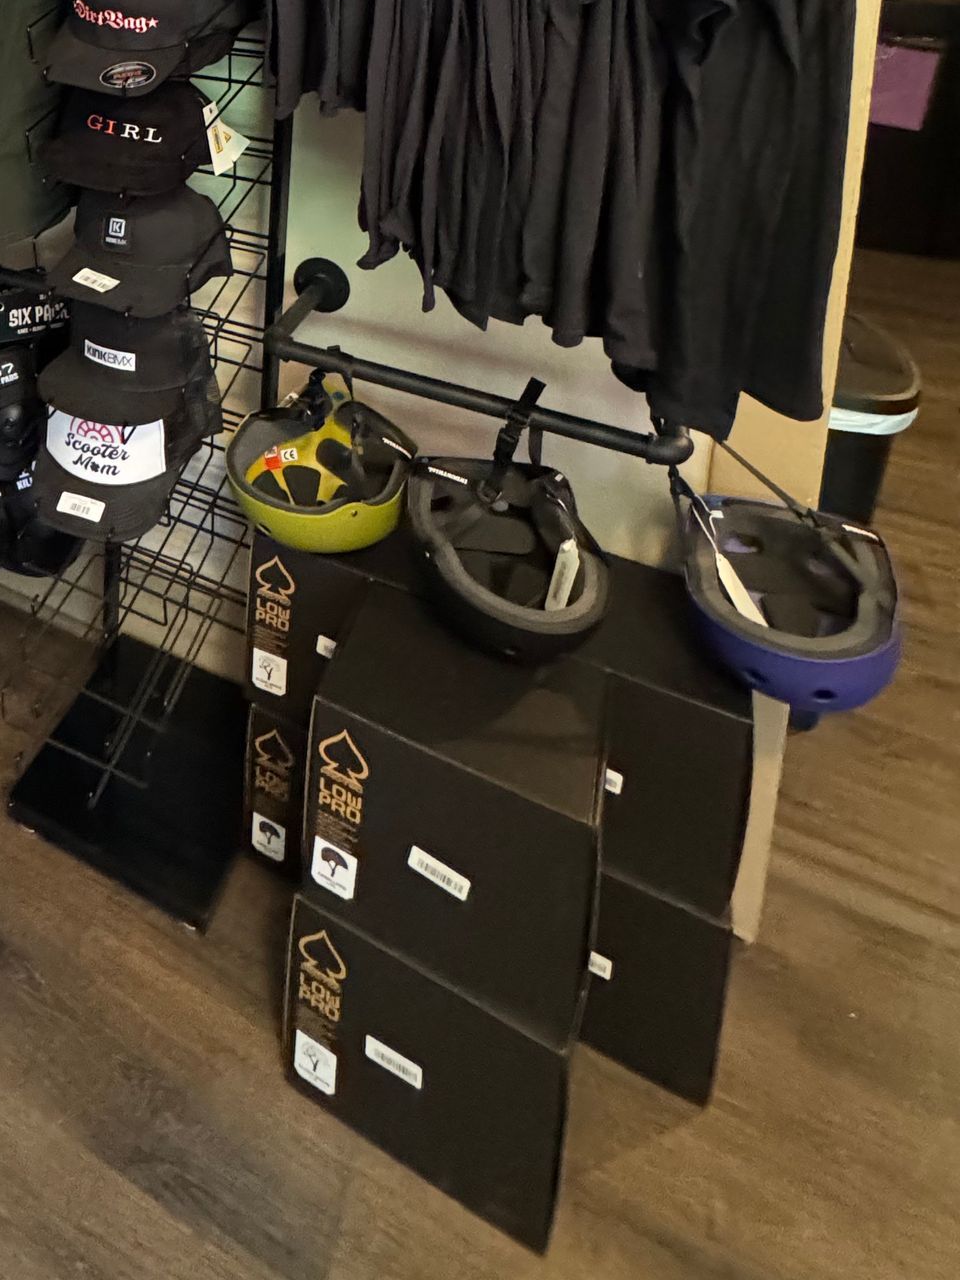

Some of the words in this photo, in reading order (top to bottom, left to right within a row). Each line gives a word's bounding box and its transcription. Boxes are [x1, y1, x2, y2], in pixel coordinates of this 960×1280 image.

[86, 114, 163, 144] GIRL
[8, 306, 33, 328] SIX
[0, 372, 19, 385] PADS
[65, 432, 130, 461] Scooter
[255, 609, 290, 632] PRO
[256, 598, 290, 620] LOW
[319, 776, 363, 809] LOW
[318, 791, 361, 824] PRO
[298, 984, 340, 1023] PRO
[300, 971, 341, 1009] LOW
